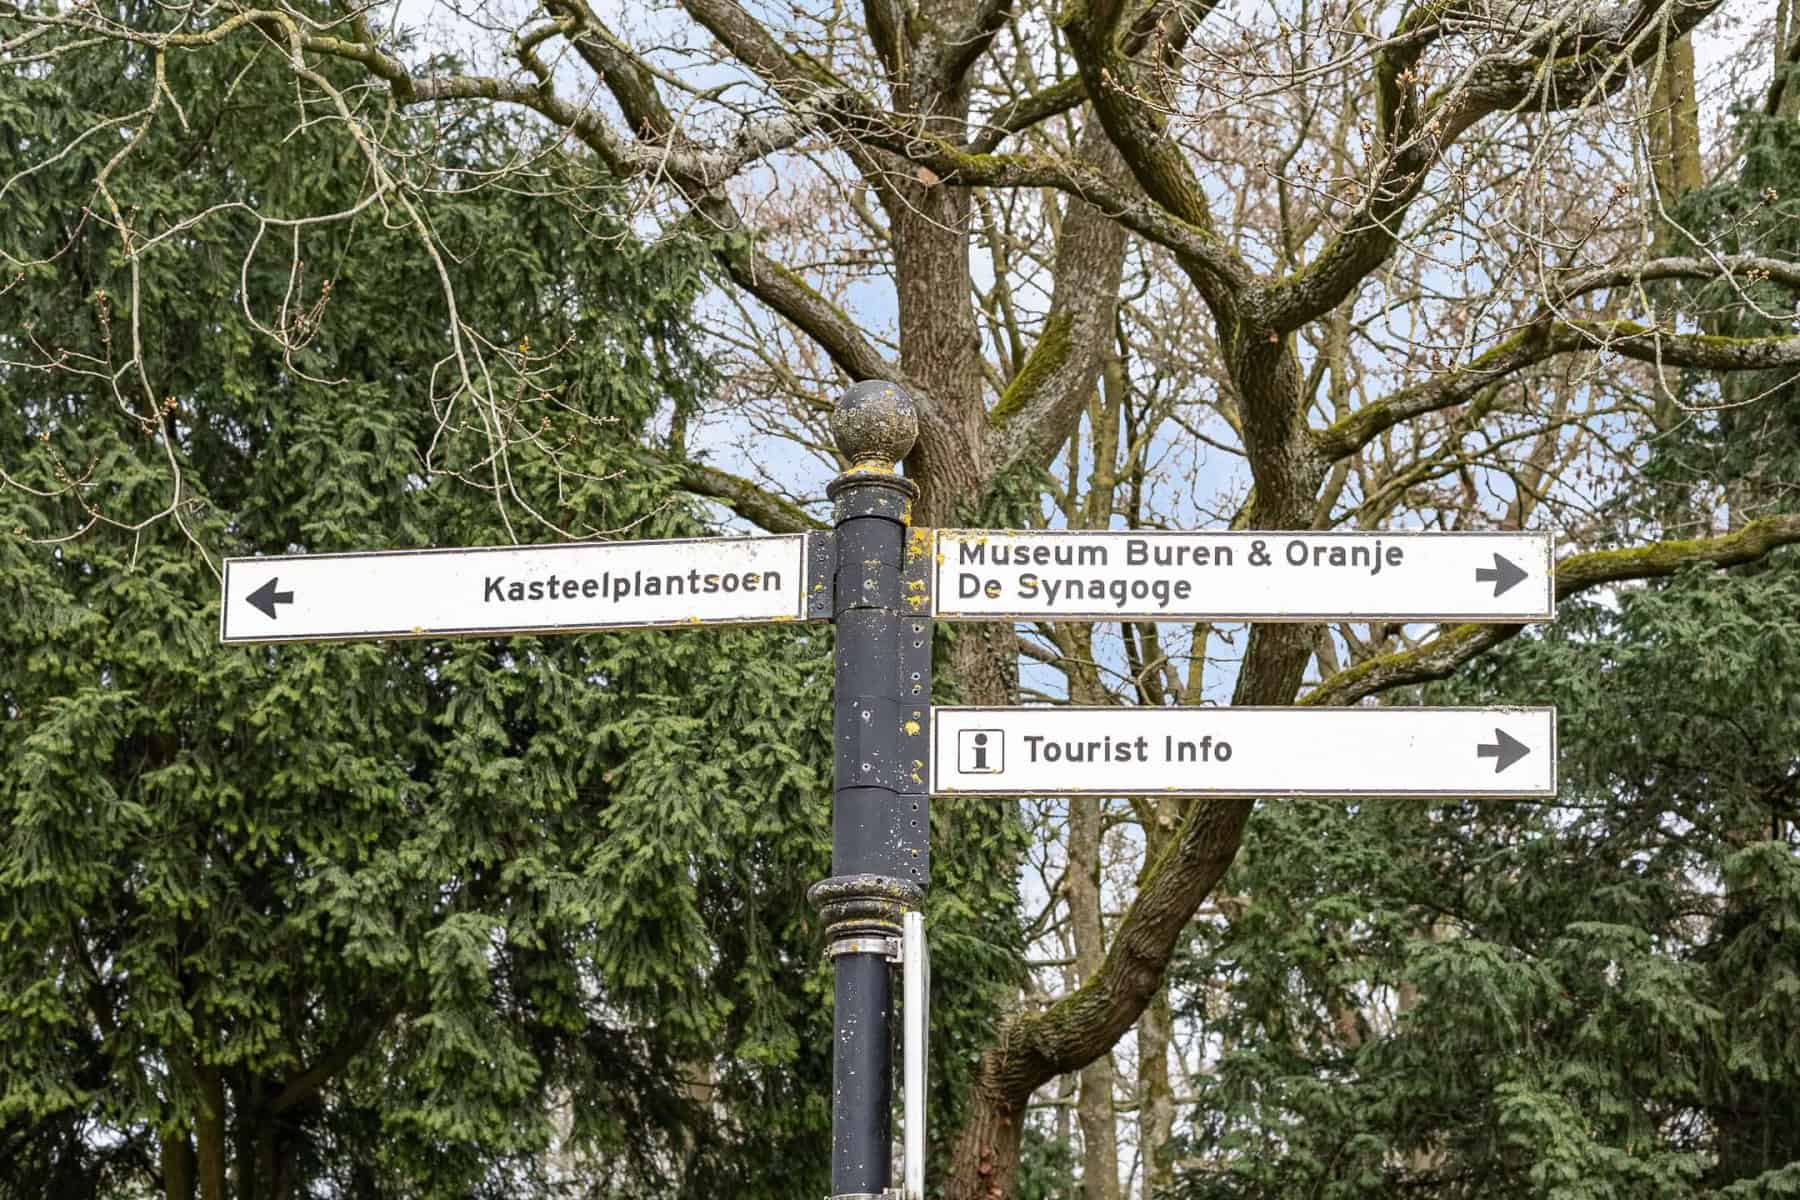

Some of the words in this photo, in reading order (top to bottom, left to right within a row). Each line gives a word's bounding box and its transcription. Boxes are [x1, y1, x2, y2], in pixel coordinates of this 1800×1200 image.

[959, 540, 1107, 566] Museum
[1127, 540, 1233, 567] Buren
[1247, 540, 1272, 567] &
[1286, 540, 1404, 574] Oranje
[484, 570, 781, 602] Kasteelplantsoen
[959, 573, 1003, 600] De
[1018, 573, 1192, 608] Synagoge
[1023, 735, 1149, 763] Tourist
[1166, 735, 1232, 763] Info
